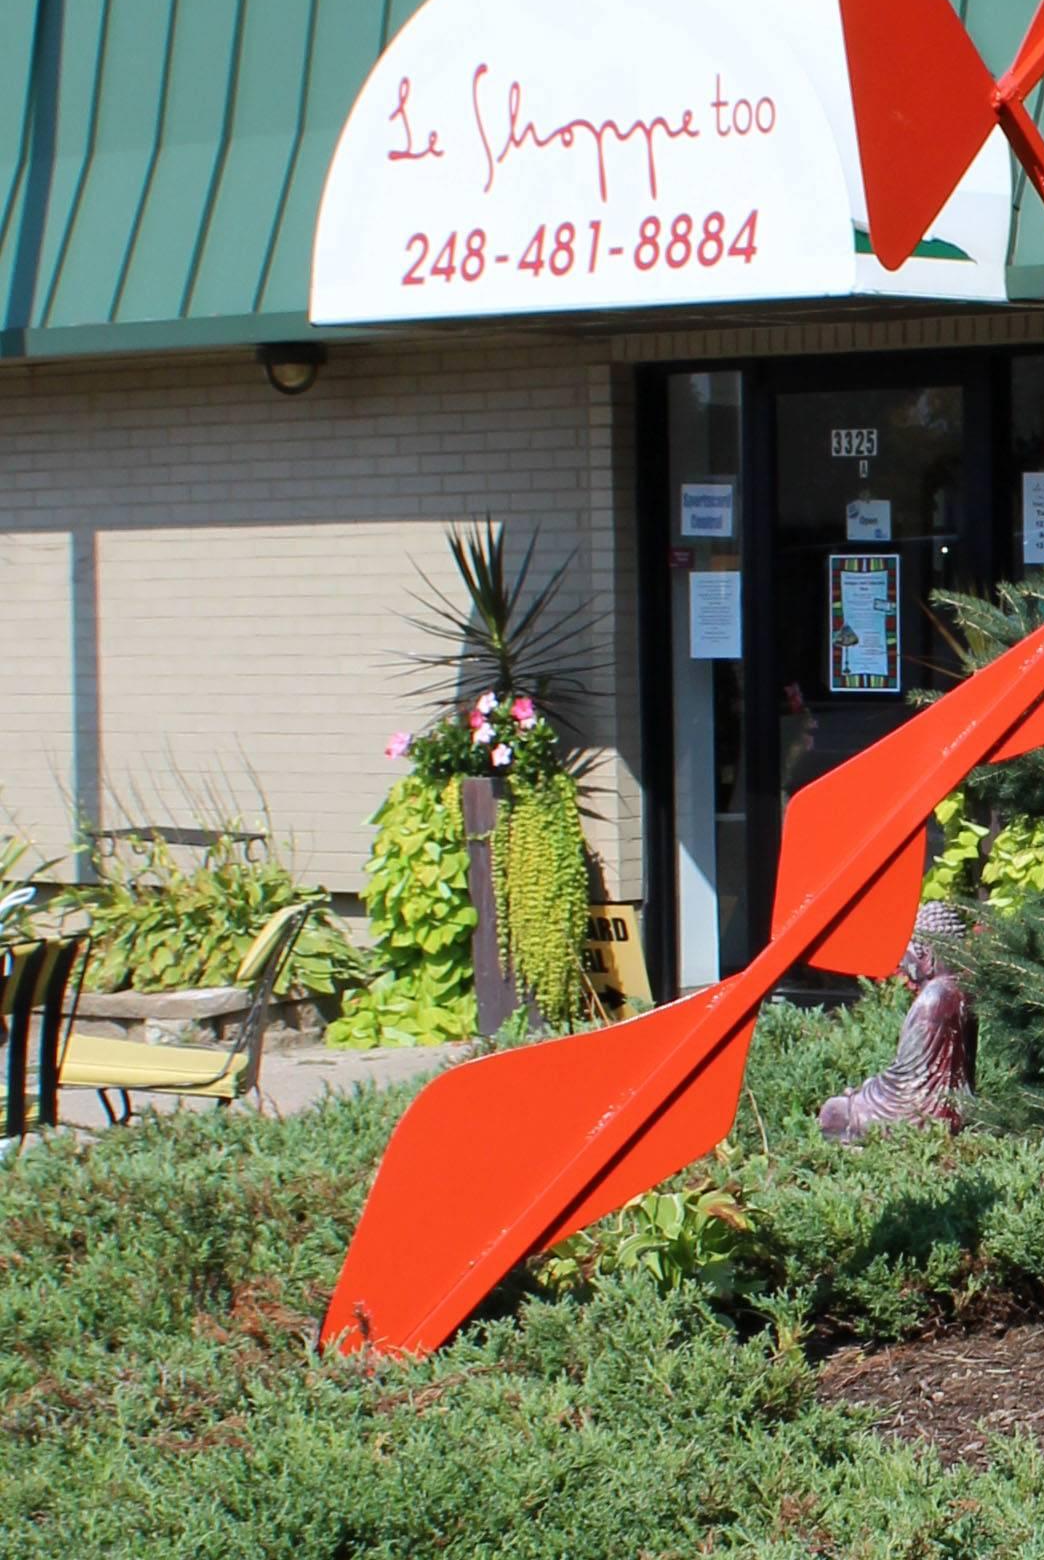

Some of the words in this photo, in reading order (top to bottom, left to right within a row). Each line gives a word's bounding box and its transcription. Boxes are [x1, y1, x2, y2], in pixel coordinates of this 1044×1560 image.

[388, 76, 445, 161] Le
[472, 63, 700, 203] Shoppe
[710, 72, 776, 137] too
[401, 209, 759, 286] 248-481-8884
[833, 429, 876, 456] 3325
[585, 917, 629, 941] ARD
